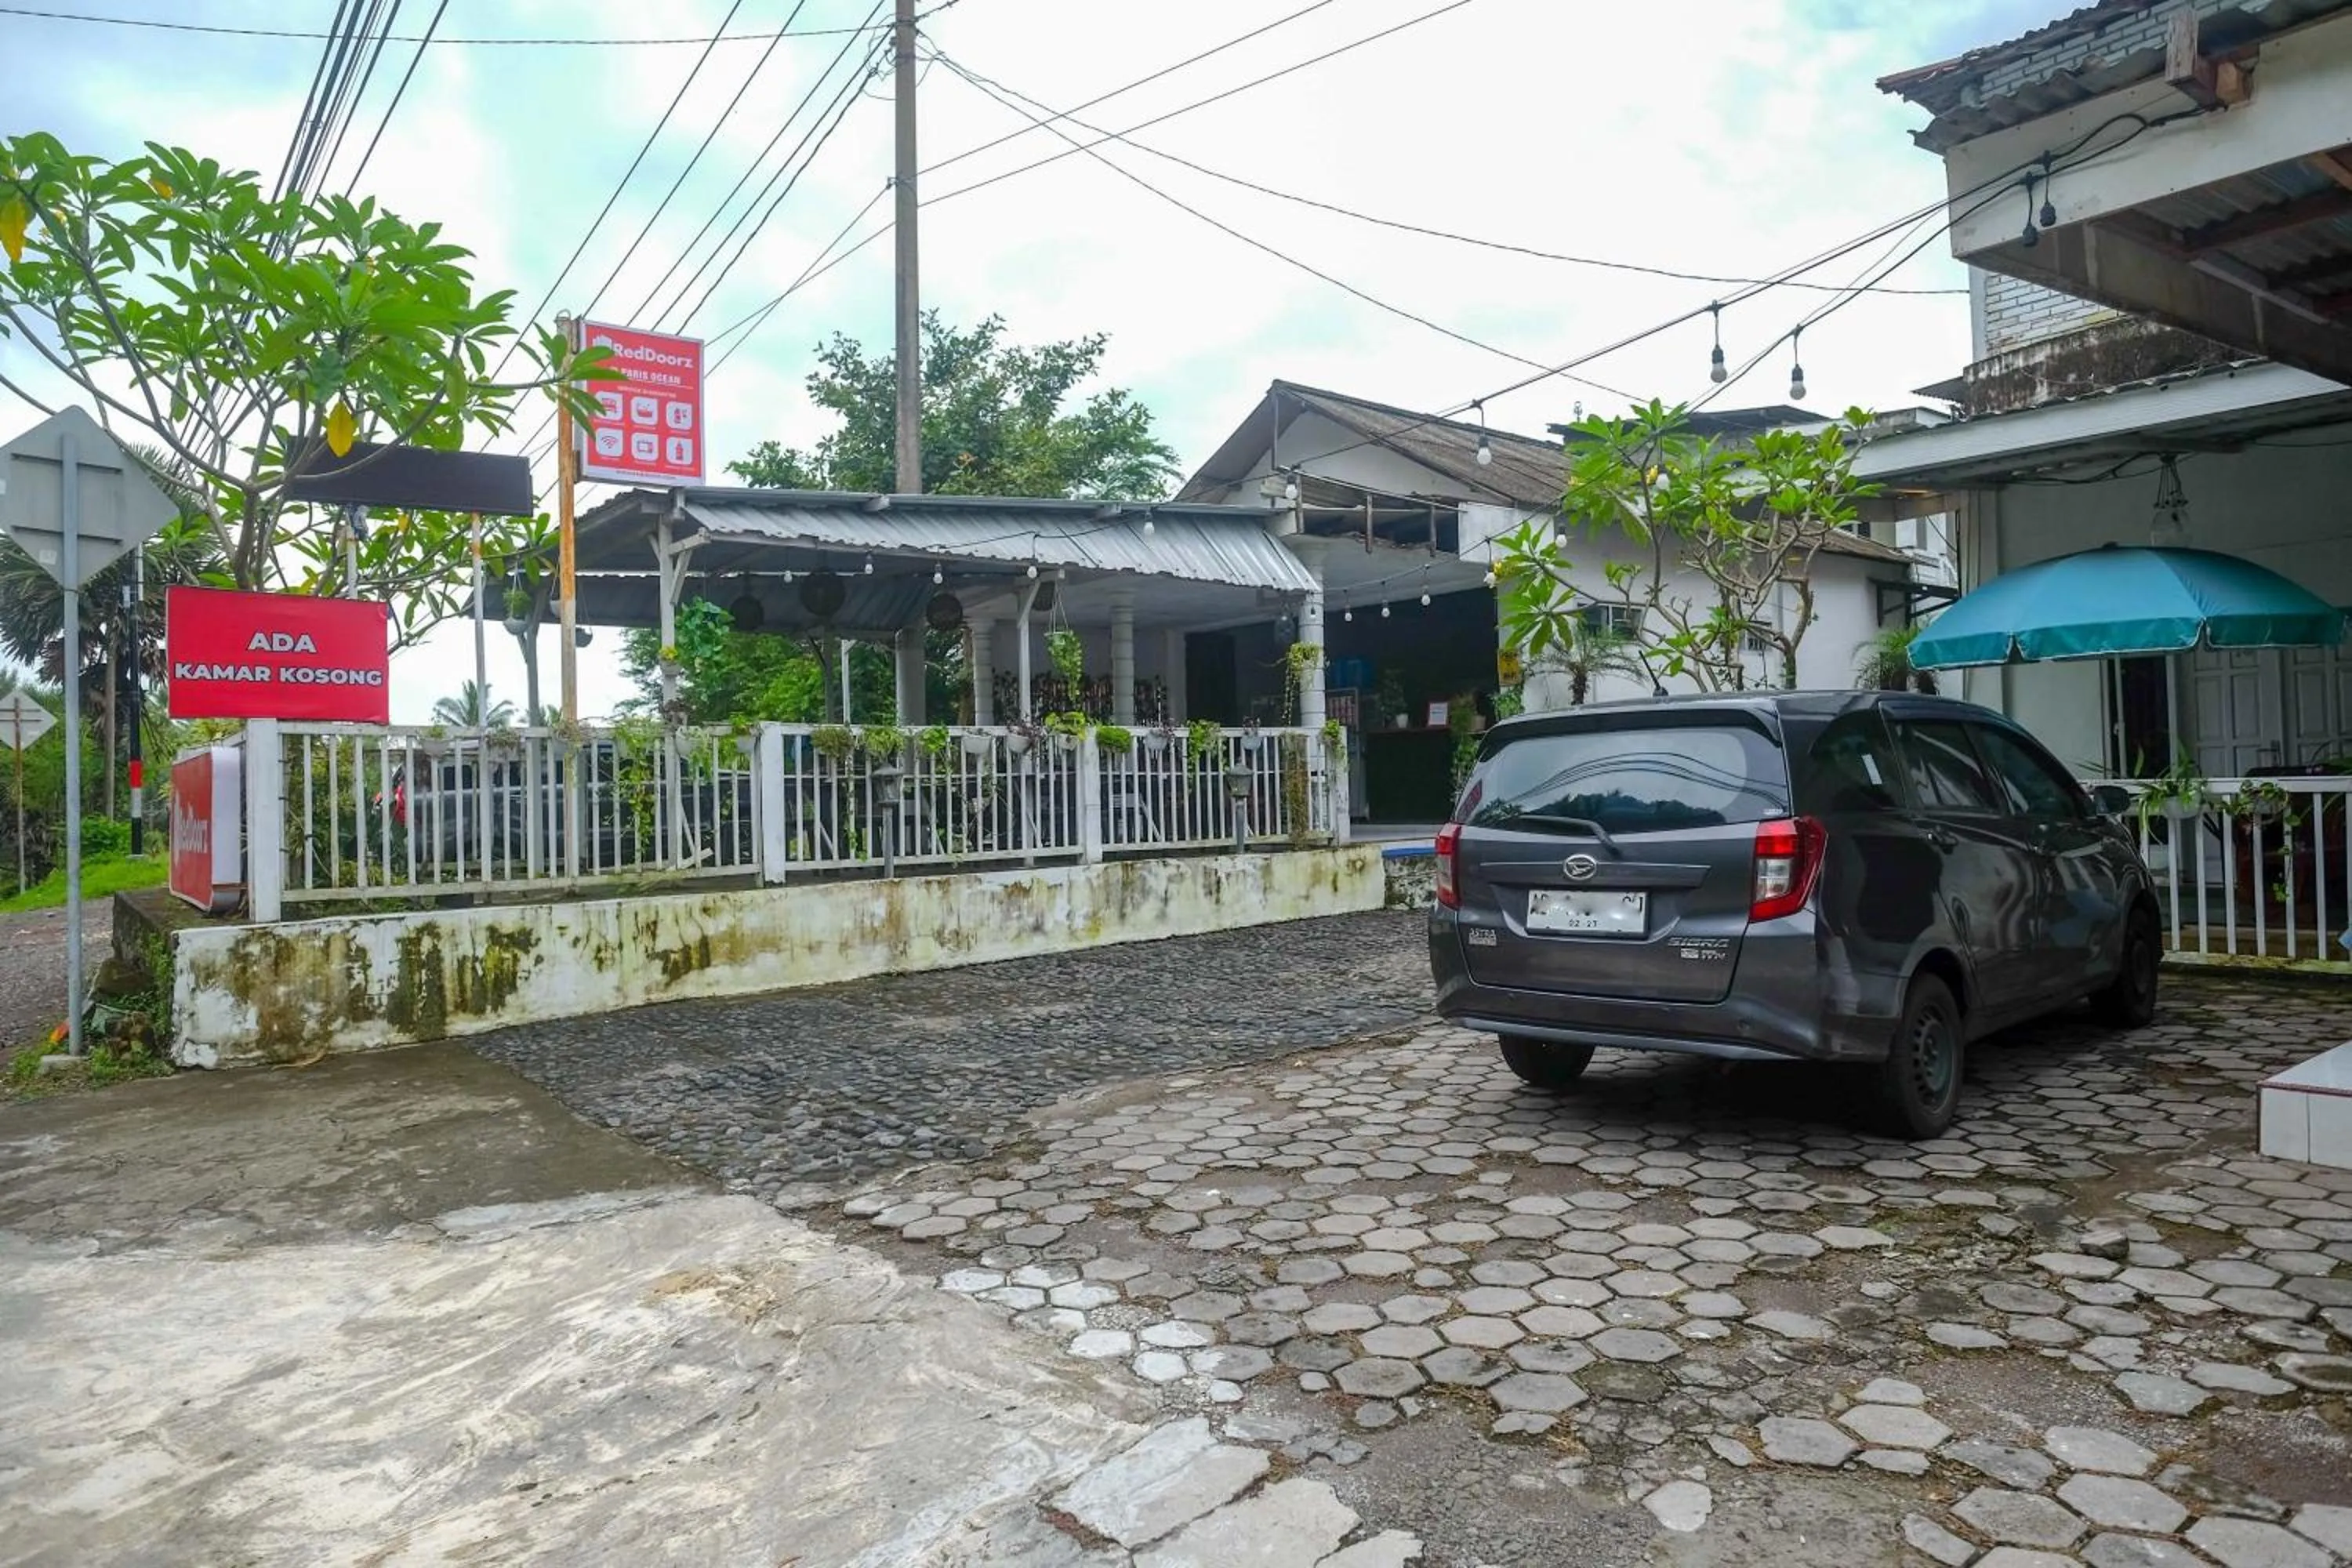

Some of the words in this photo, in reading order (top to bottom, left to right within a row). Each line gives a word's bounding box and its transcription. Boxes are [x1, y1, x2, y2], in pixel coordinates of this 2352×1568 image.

[613, 343, 694, 368] RedDoorz
[248, 632, 317, 653] ADA
[174, 662, 270, 681] KAMAR
[279, 666, 382, 685] KOSONG
